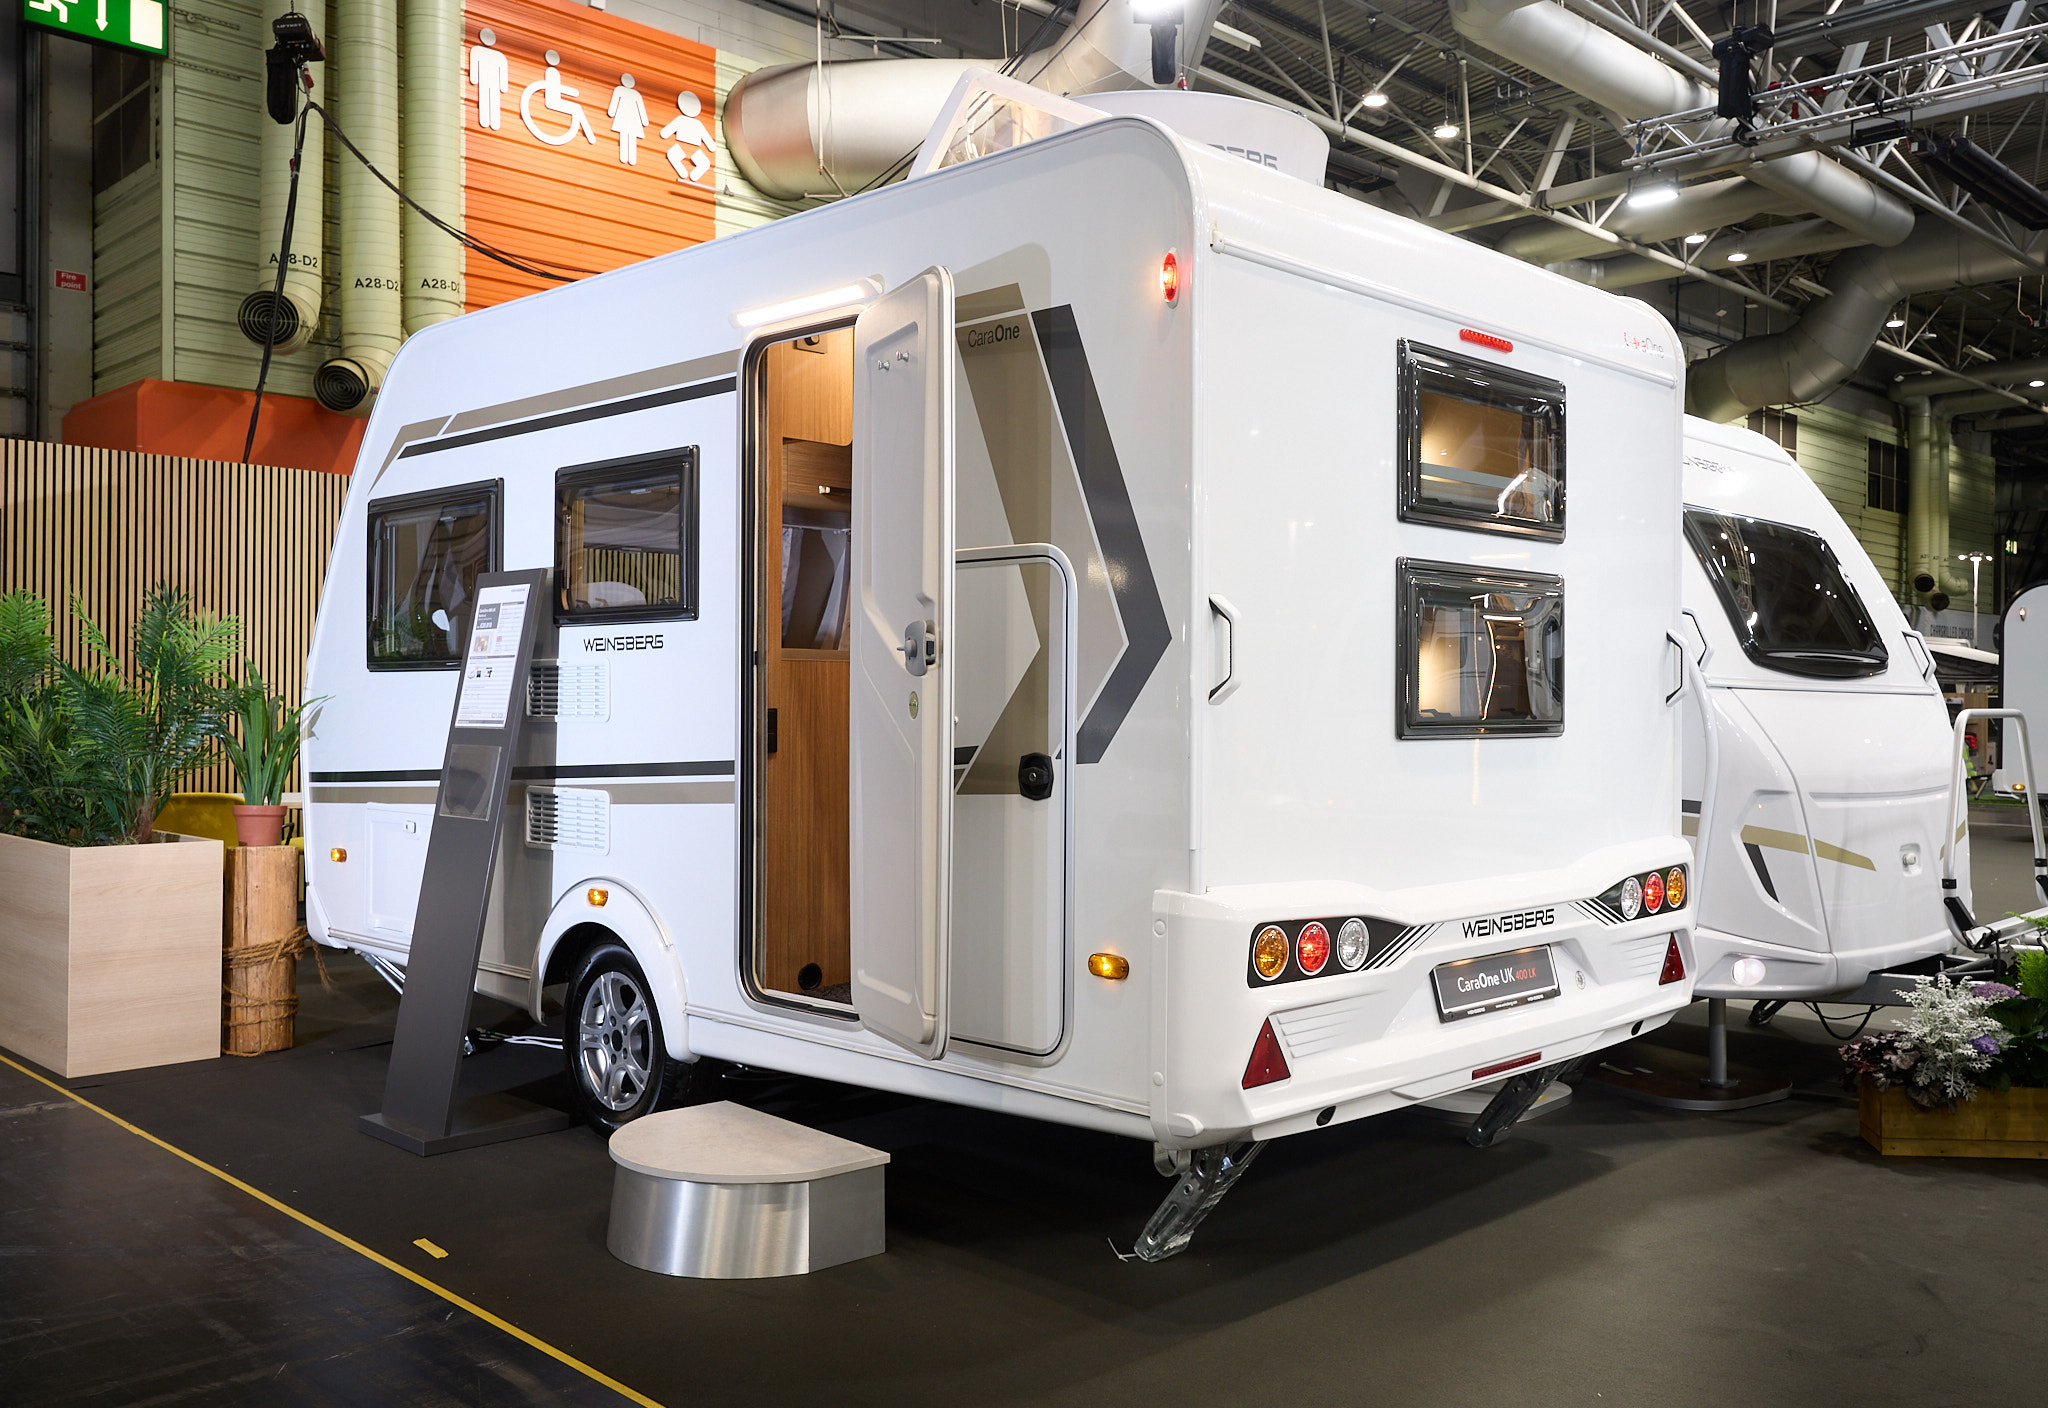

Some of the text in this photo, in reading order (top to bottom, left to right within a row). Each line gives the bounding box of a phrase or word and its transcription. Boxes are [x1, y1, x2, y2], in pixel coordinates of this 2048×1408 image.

[269, 253, 318, 268] A8-D2
[61, 272, 77, 280] Fire
[61, 281, 82, 289] point
[968, 324, 1020, 347] CaraOne
[583, 634, 664, 652] WEINSBERG
[1462, 908, 1555, 939] WEINSBERG
[1457, 967, 1537, 993] CaraOne UK 400 LK
